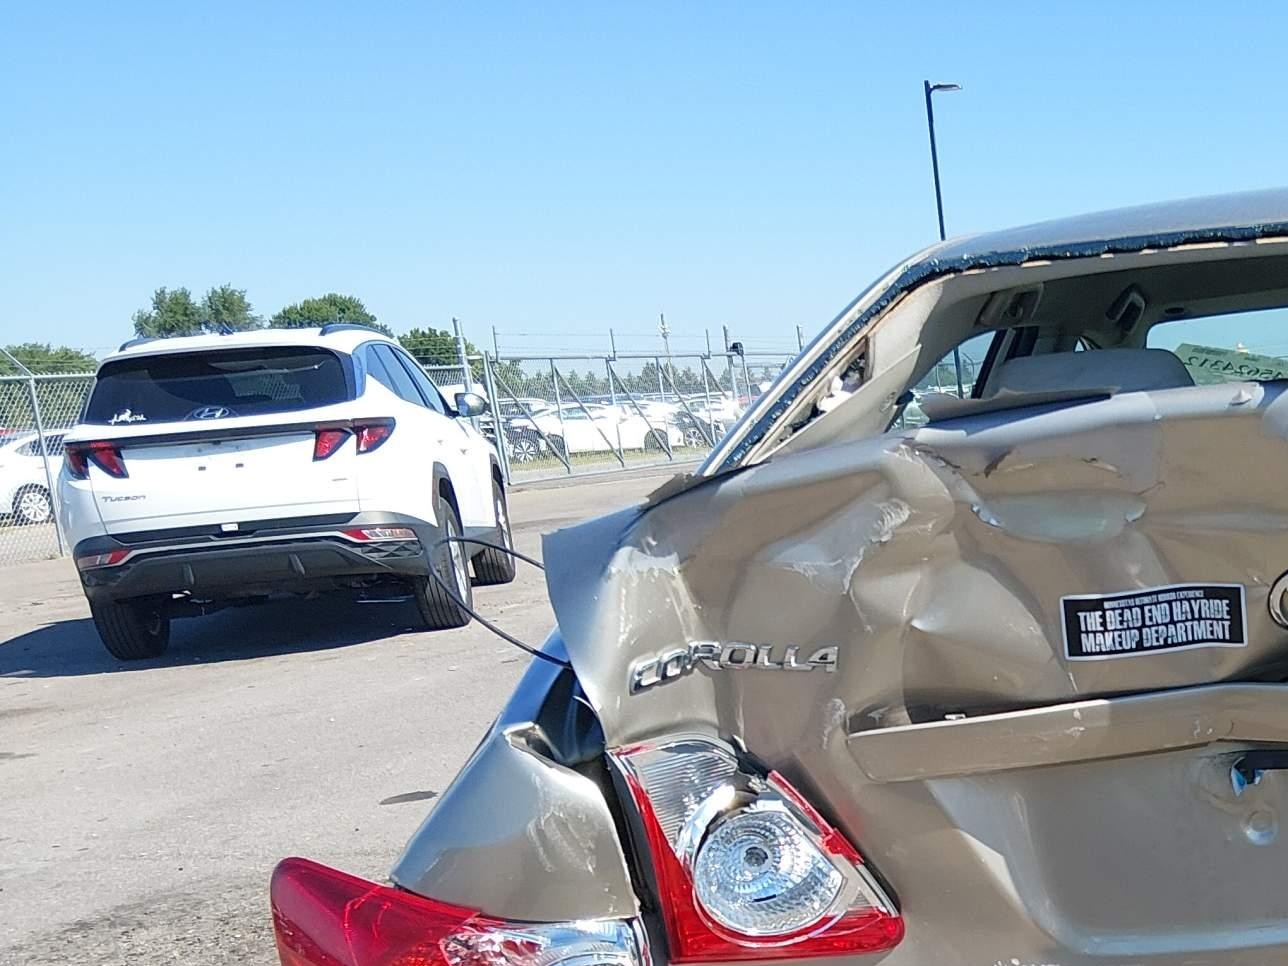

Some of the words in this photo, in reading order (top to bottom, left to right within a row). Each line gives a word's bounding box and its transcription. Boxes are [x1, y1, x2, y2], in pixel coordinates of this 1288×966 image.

[1076, 611, 1105, 632] THE
[1105, 606, 1142, 631] DEAD
[1144, 602, 1171, 626] END
[1172, 599, 1232, 622] HAYRIDE
[1080, 628, 1140, 653] MAKEUP
[1141, 620, 1232, 648] DEPARTMENT
[628, 641, 841, 696] COROLLA
